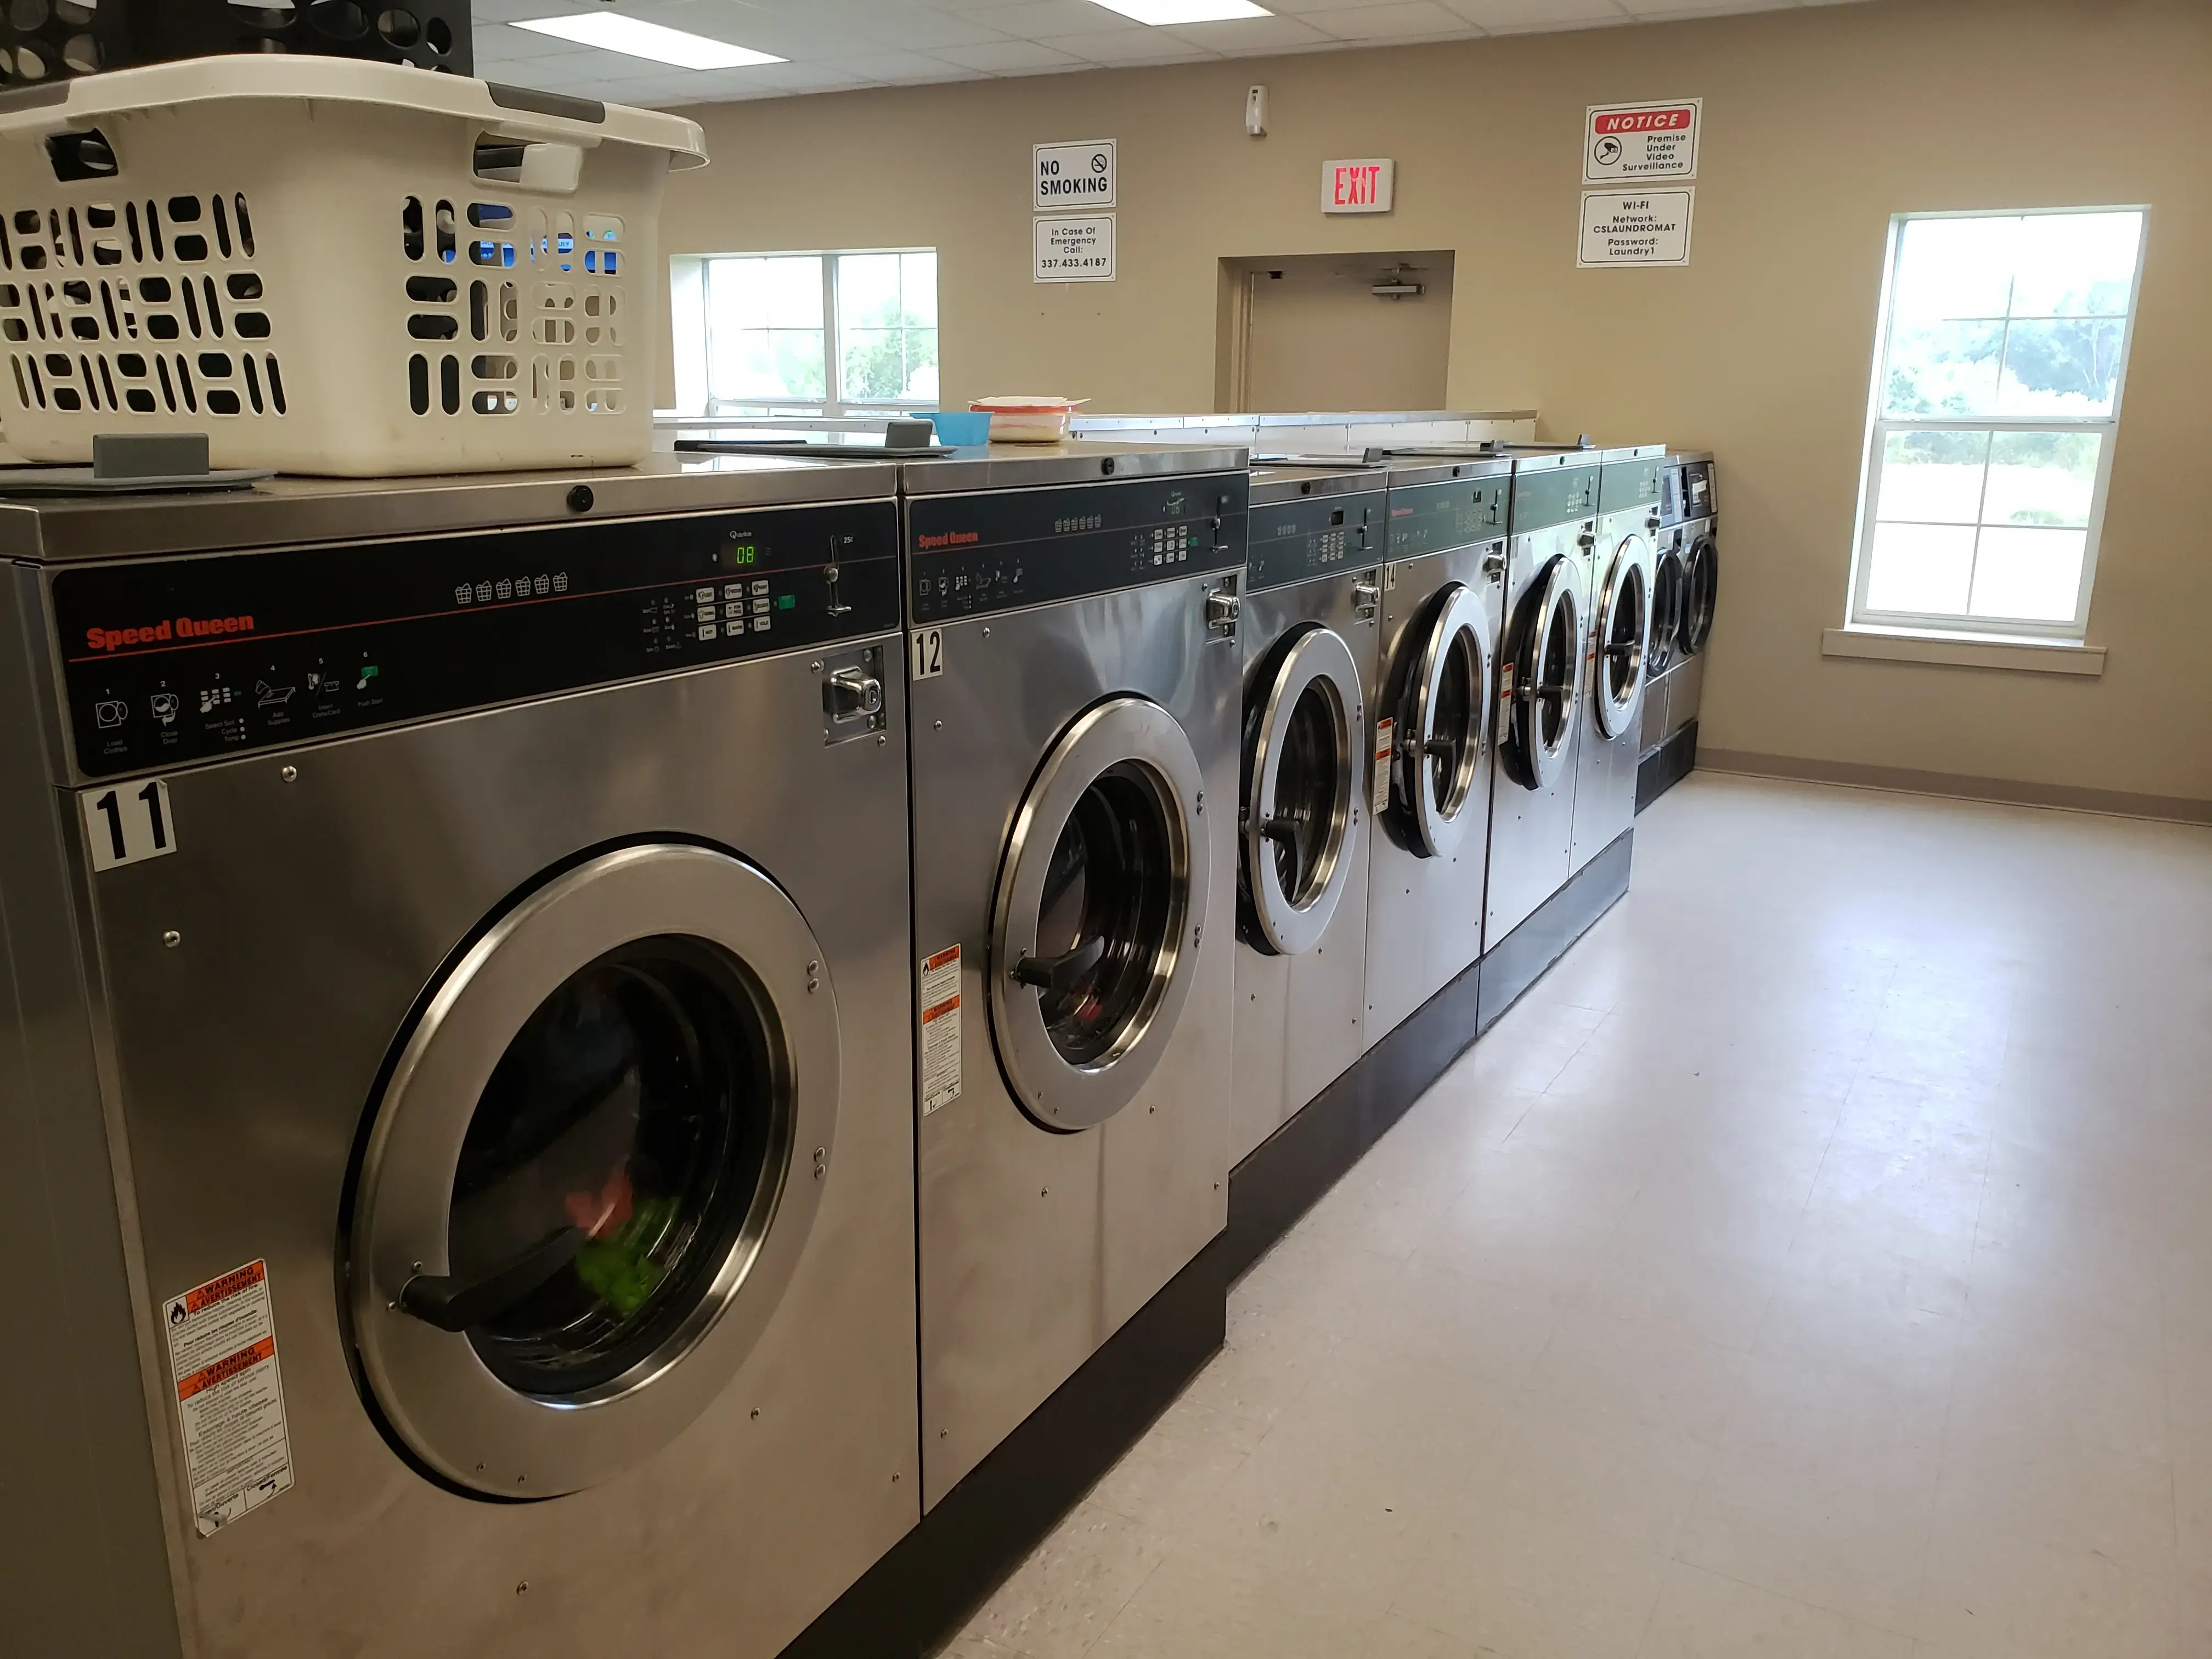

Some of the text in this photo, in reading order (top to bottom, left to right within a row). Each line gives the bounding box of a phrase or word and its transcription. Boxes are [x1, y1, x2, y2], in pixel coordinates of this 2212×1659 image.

[1607, 114, 1679, 131] NOTICE
[1647, 134, 1686, 143] Premise
[1646, 144, 1676, 152] Under
[1041, 160, 1059, 176] NO
[1622, 162, 1684, 171] Surveillance
[1041, 177, 1107, 195] SMOKING
[1334, 166, 1380, 205] EXIT
[1623, 201, 1649, 210] WI-FI
[1613, 215, 1657, 223] Network:
[1594, 224, 1676, 233] CSLAUNDROMAT
[1051, 238, 1096, 246] Emergency
[1608, 238, 1658, 246] Password:
[1609, 247, 1654, 256] Laundry1
[1041, 258, 1107, 268] 337.433.4187
[919, 531, 978, 549] Speed Queen
[737, 546, 754, 564] 08
[1387, 563, 1395, 590] 14
[87, 615, 255, 651] Speed Queen
[916, 631, 940, 675] 12
[96, 781, 167, 860] 11
[205, 1267, 254, 1294] WARNING
[201, 1272, 261, 1308] AVERTISSEMENT
[206, 1347, 255, 1375] WARNING
[202, 1352, 262, 1389] AVERTISSEMENT
